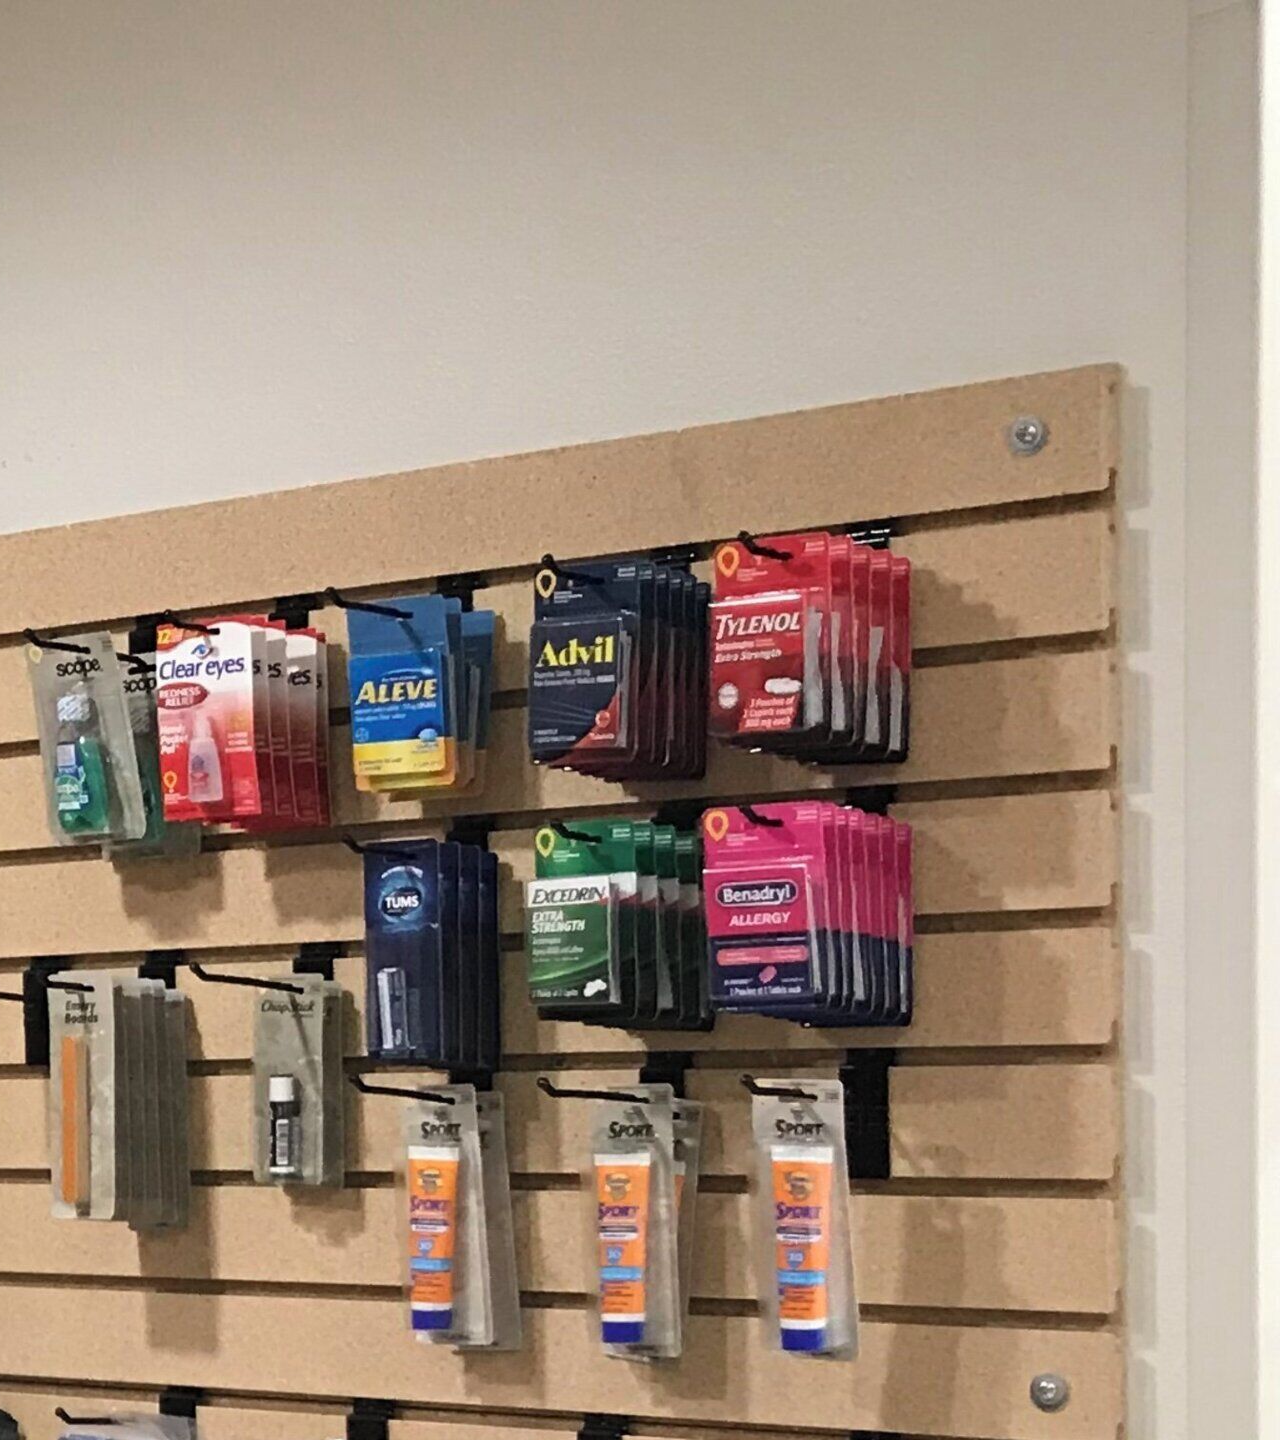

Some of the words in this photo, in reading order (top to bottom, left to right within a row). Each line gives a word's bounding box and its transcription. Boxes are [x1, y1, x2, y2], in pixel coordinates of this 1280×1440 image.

[715, 612, 801, 640] TYLENOL
[536, 635, 614, 668] Advil
[56, 658, 101, 678] scope
[159, 660, 204, 681] Clear
[205, 657, 245, 679] eyes
[355, 679, 438, 705] ALEVE
[385, 895, 419, 909] TUMS
[532, 887, 606, 904] EXCEDRIN
[722, 884, 791, 902] Benadryl
[532, 910, 564, 922] EXTRA
[728, 911, 792, 927] ALLERGY
[531, 920, 586, 934] STRENGTH
[421, 1121, 462, 1139] SPORT
[608, 1121, 654, 1139] SPORT
[775, 1118, 825, 1139] SPORT
[410, 1196, 448, 1212] SPORT
[598, 1202, 639, 1220] SPORT
[776, 1201, 822, 1220] SPORT
